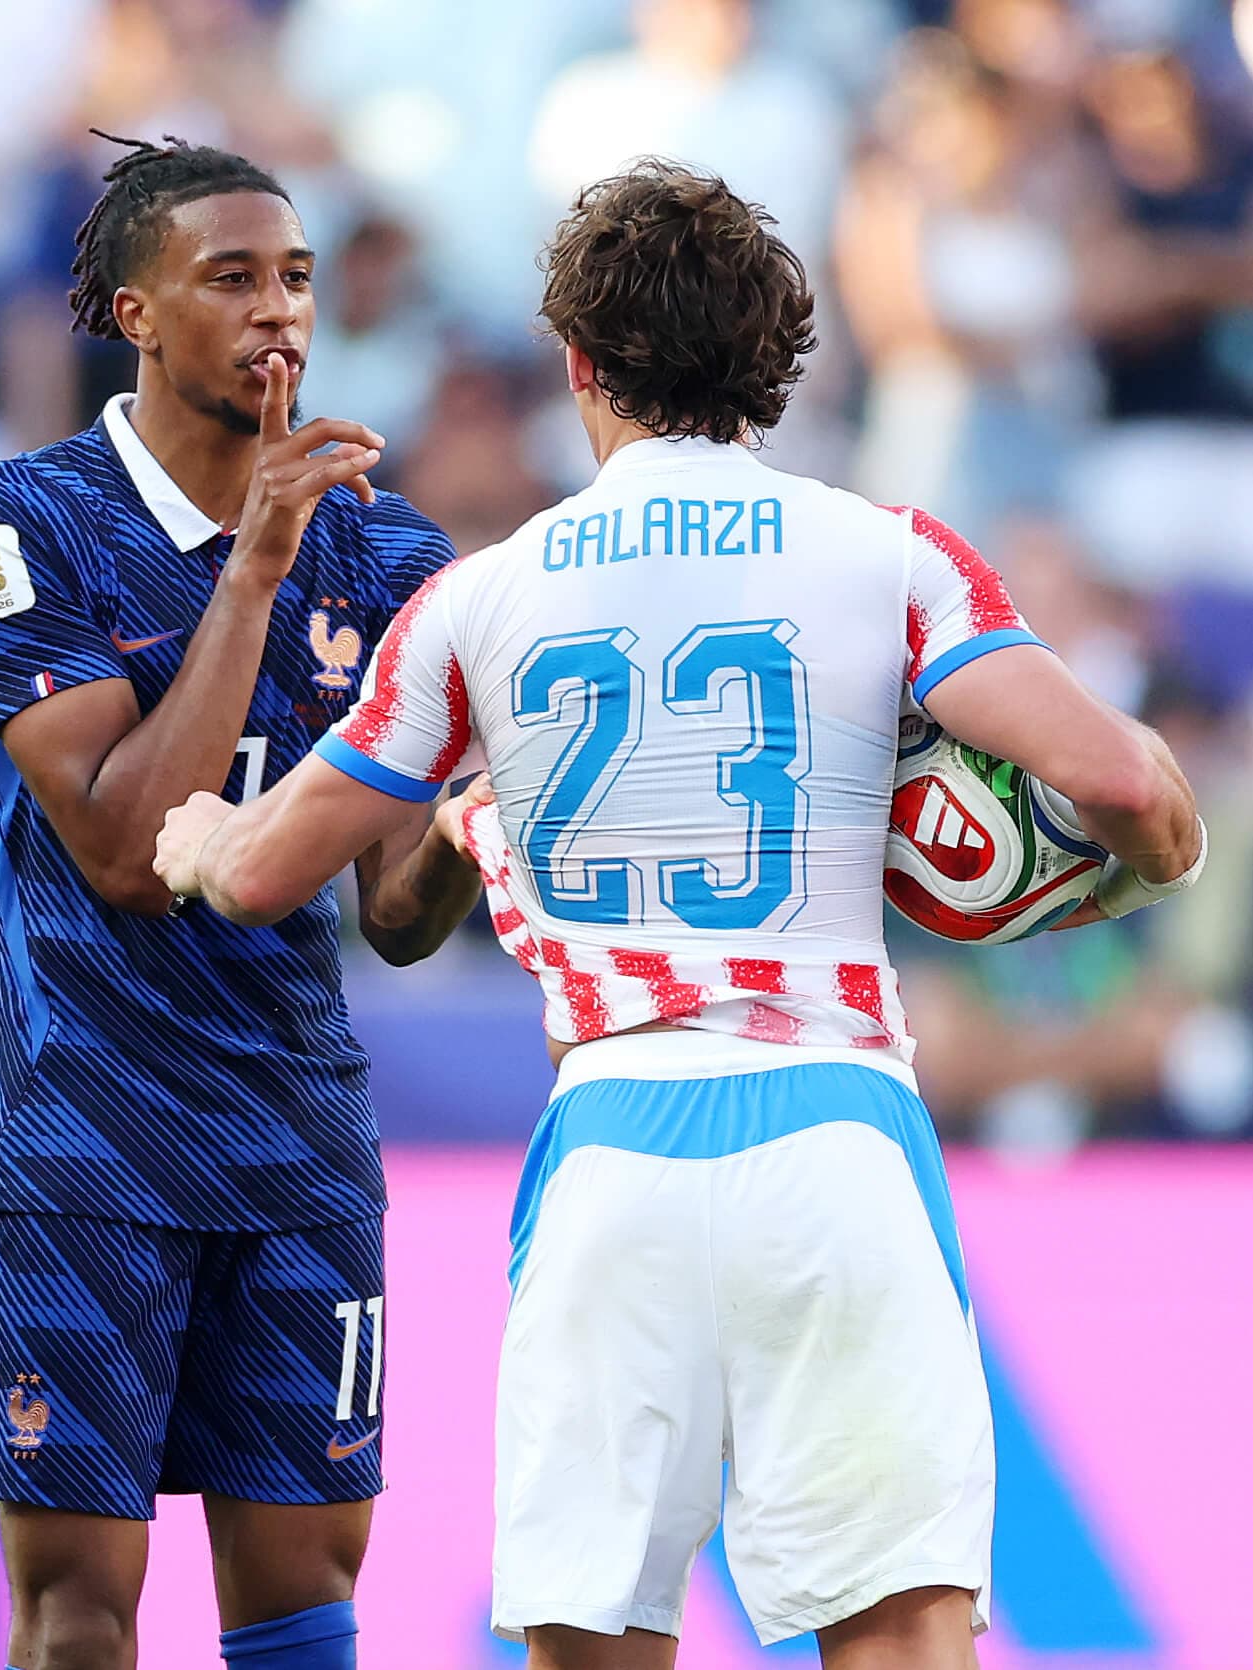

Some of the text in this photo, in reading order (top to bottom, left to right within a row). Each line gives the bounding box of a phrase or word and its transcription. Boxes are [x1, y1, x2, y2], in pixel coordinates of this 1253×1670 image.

[543, 498, 783, 572] GALARZA
[510, 619, 812, 933] 23
[334, 1295, 384, 1421] 11
